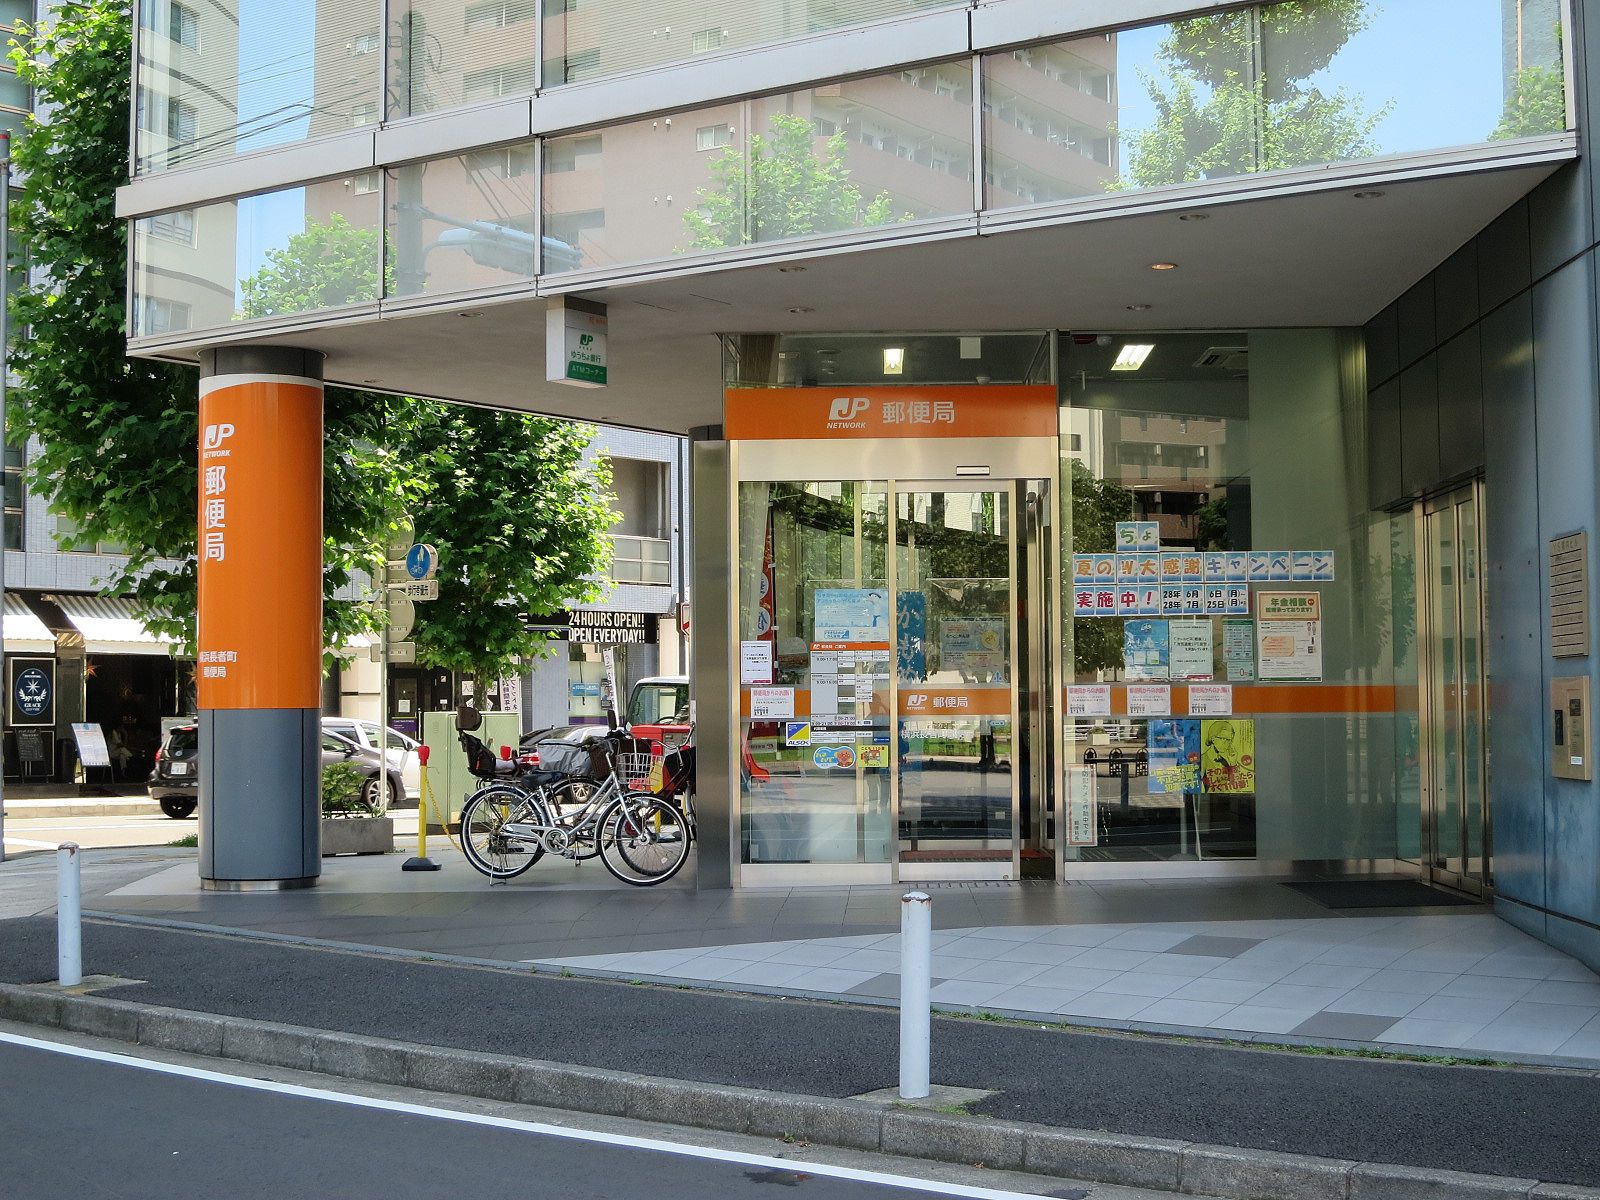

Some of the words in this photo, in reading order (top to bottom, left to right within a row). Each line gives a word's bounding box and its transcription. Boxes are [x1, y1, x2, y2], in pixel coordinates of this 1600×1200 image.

[570, 349, 602, 364] ゆうちょ銀行
[572, 365, 605, 376] ATMコーナー
[829, 397, 871, 420] JP
[882, 400, 955, 424] 郵便局
[826, 421, 866, 429] NETWORK
[204, 423, 235, 449] JP
[204, 465, 226, 562] 郵便局
[568, 611, 580, 626] 24
[581, 611, 613, 627] HOURS
[613, 612, 645, 628] OPEN!!
[568, 627, 592, 643] OPEN
[593, 628, 645, 644] EVERYDAY!!
[203, 666, 227, 678] 郵便局
[932, 696, 968, 708] 郵便局
